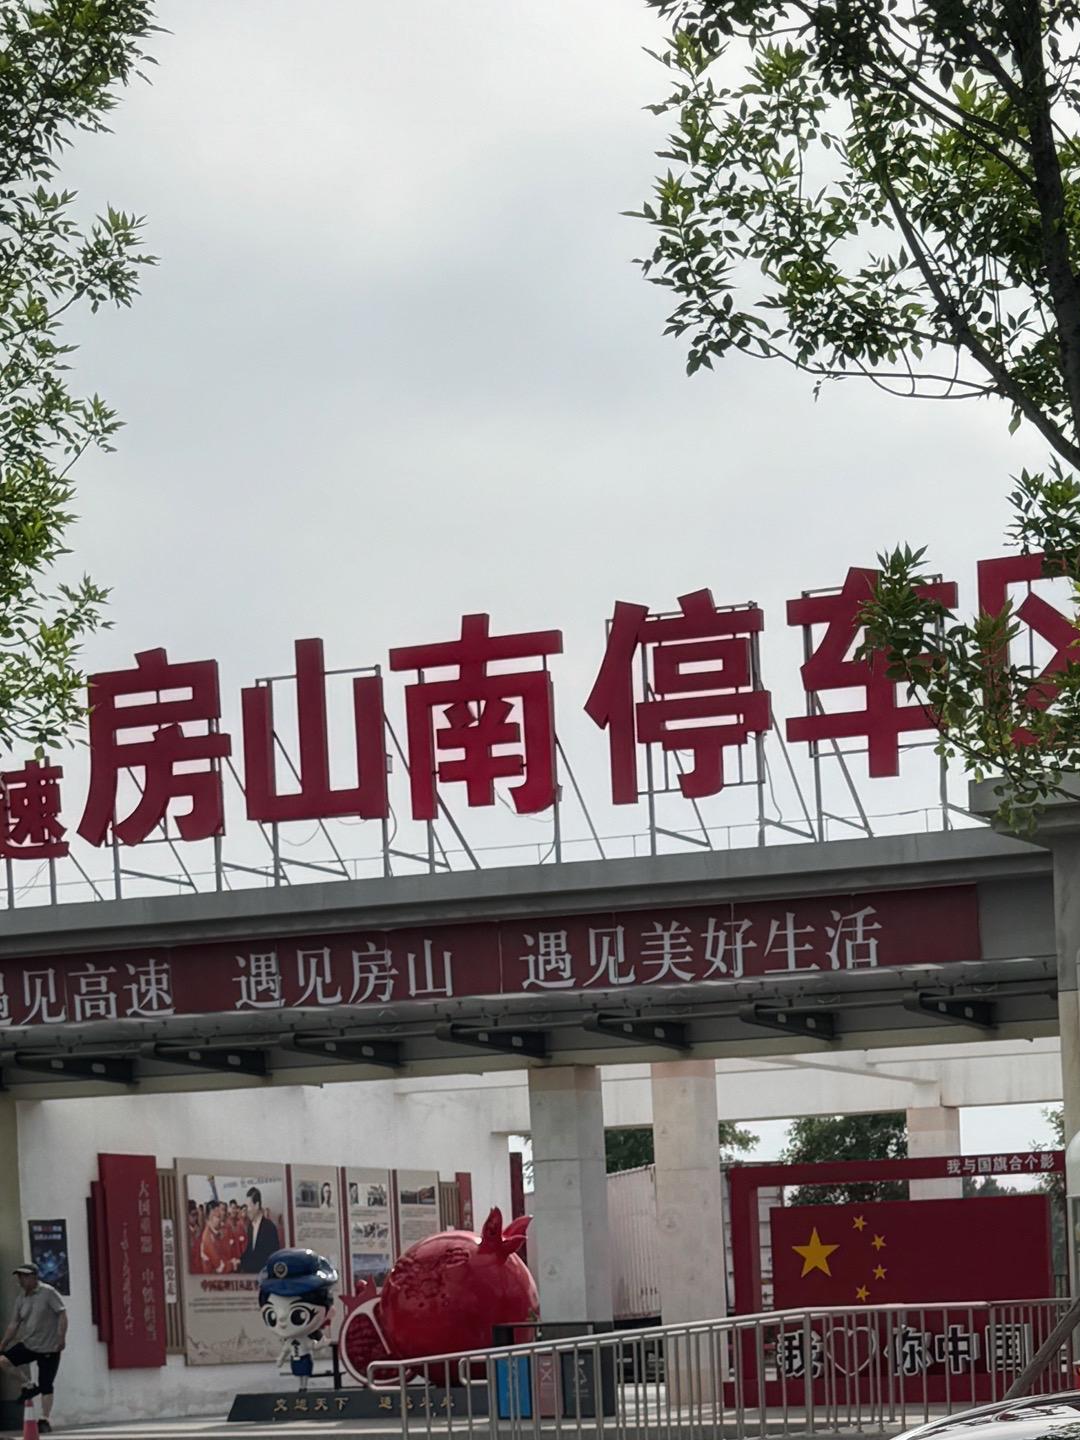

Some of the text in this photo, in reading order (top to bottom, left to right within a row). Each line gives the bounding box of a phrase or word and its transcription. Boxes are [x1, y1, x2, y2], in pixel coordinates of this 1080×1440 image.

[0, 905, 882, 1026] 见高速 遇见房山 遇见美好生活
[946, 1153, 1055, 1175] 我与国旗合个影
